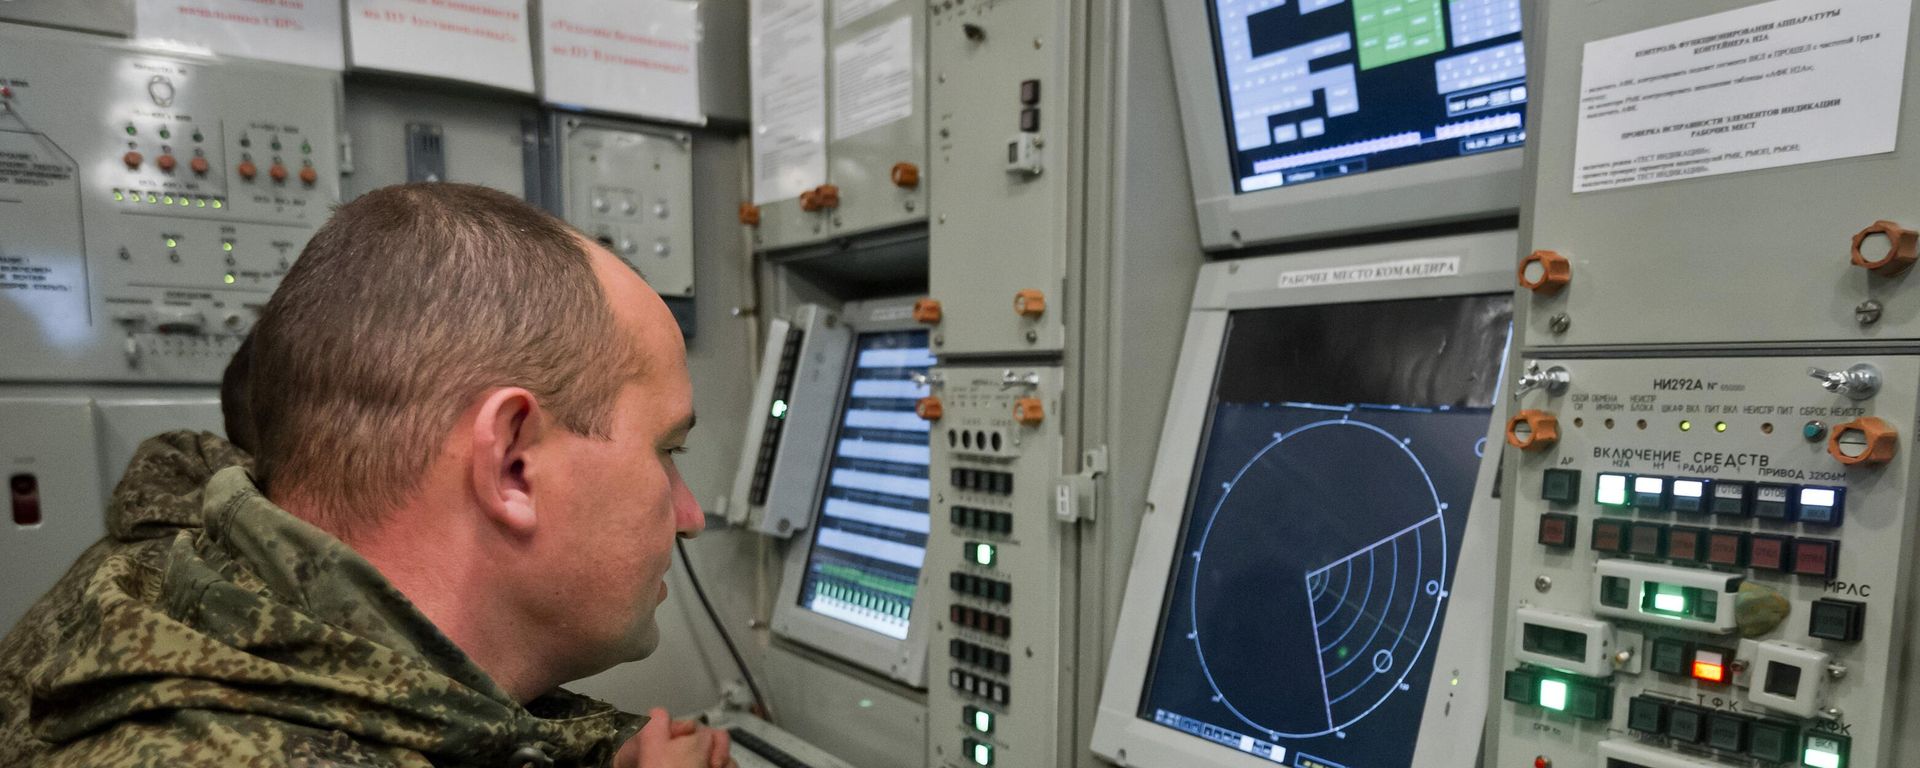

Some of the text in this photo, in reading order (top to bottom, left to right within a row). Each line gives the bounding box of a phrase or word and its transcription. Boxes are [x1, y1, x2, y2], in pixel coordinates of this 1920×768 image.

[1635, 8, 1841, 58] КОНТРОЛЬ ФУНКЦИОНИРОВАНИЯ АППАРАТУРЫ
[1693, 37, 1750, 55] КОНТЕЙНЕРА
[1621, 98, 1841, 140] ПРОВЕРКА ИСПРАВНОСТИ ЭЛЕМЕНТОВ ИНДИКАЦИИ
[1690, 122, 1757, 138] РАБОЧИХ МЕСТ
[1281, 262, 1455, 286] РАБОЧЕЕ МЕСТО КОМАНДИРА
[1653, 379, 1703, 391] НИ292А
[1592, 394, 1618, 402] ОБМЕНА
[1630, 395, 1657, 403] НЕИСПР
[1661, 404, 1700, 413] ШКАФ ВКЛ
[1705, 405, 1738, 414] ПИТ ВКЛ
[1743, 406, 1793, 415] НЕИСПР ПИТ
[1800, 406, 1866, 416] СБРОС НЕИСПР
[1594, 447, 1769, 467] ВКЛЮЧЕНИЕ СРЕДСТВ
[1612, 460, 1630, 468] Н2А
[1683, 463, 1719, 474] РАДИО
[1758, 468, 1805, 480] ПРИВОД
[1824, 581, 1871, 597] МРЛС
[1815, 721, 1852, 735] АФК
